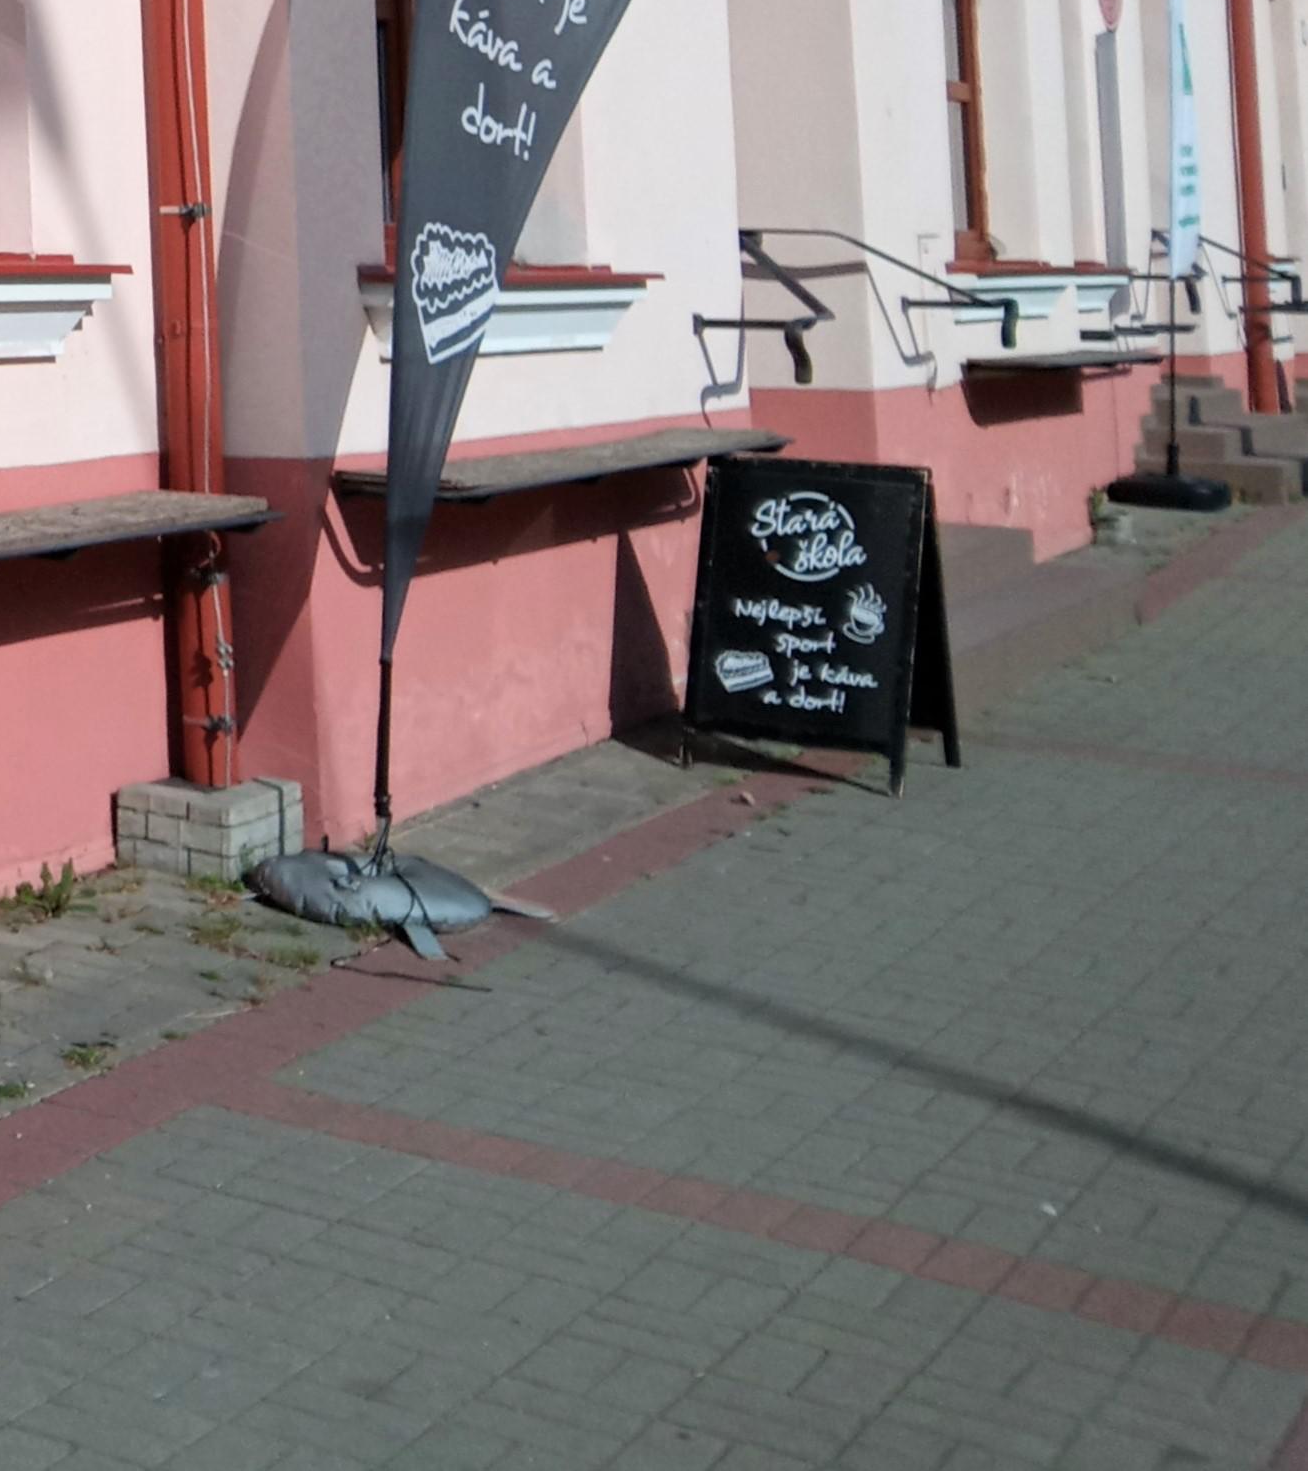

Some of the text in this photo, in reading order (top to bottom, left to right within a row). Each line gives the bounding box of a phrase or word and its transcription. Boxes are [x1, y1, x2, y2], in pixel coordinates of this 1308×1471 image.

[532, 58, 556, 89] a
[461, 82, 536, 161] dort!
[751, 498, 840, 537] Stará
[794, 530, 867, 572] škola
[775, 631, 836, 659] sport
[790, 659, 878, 688] je káva
[762, 686, 845, 714] a dort!
